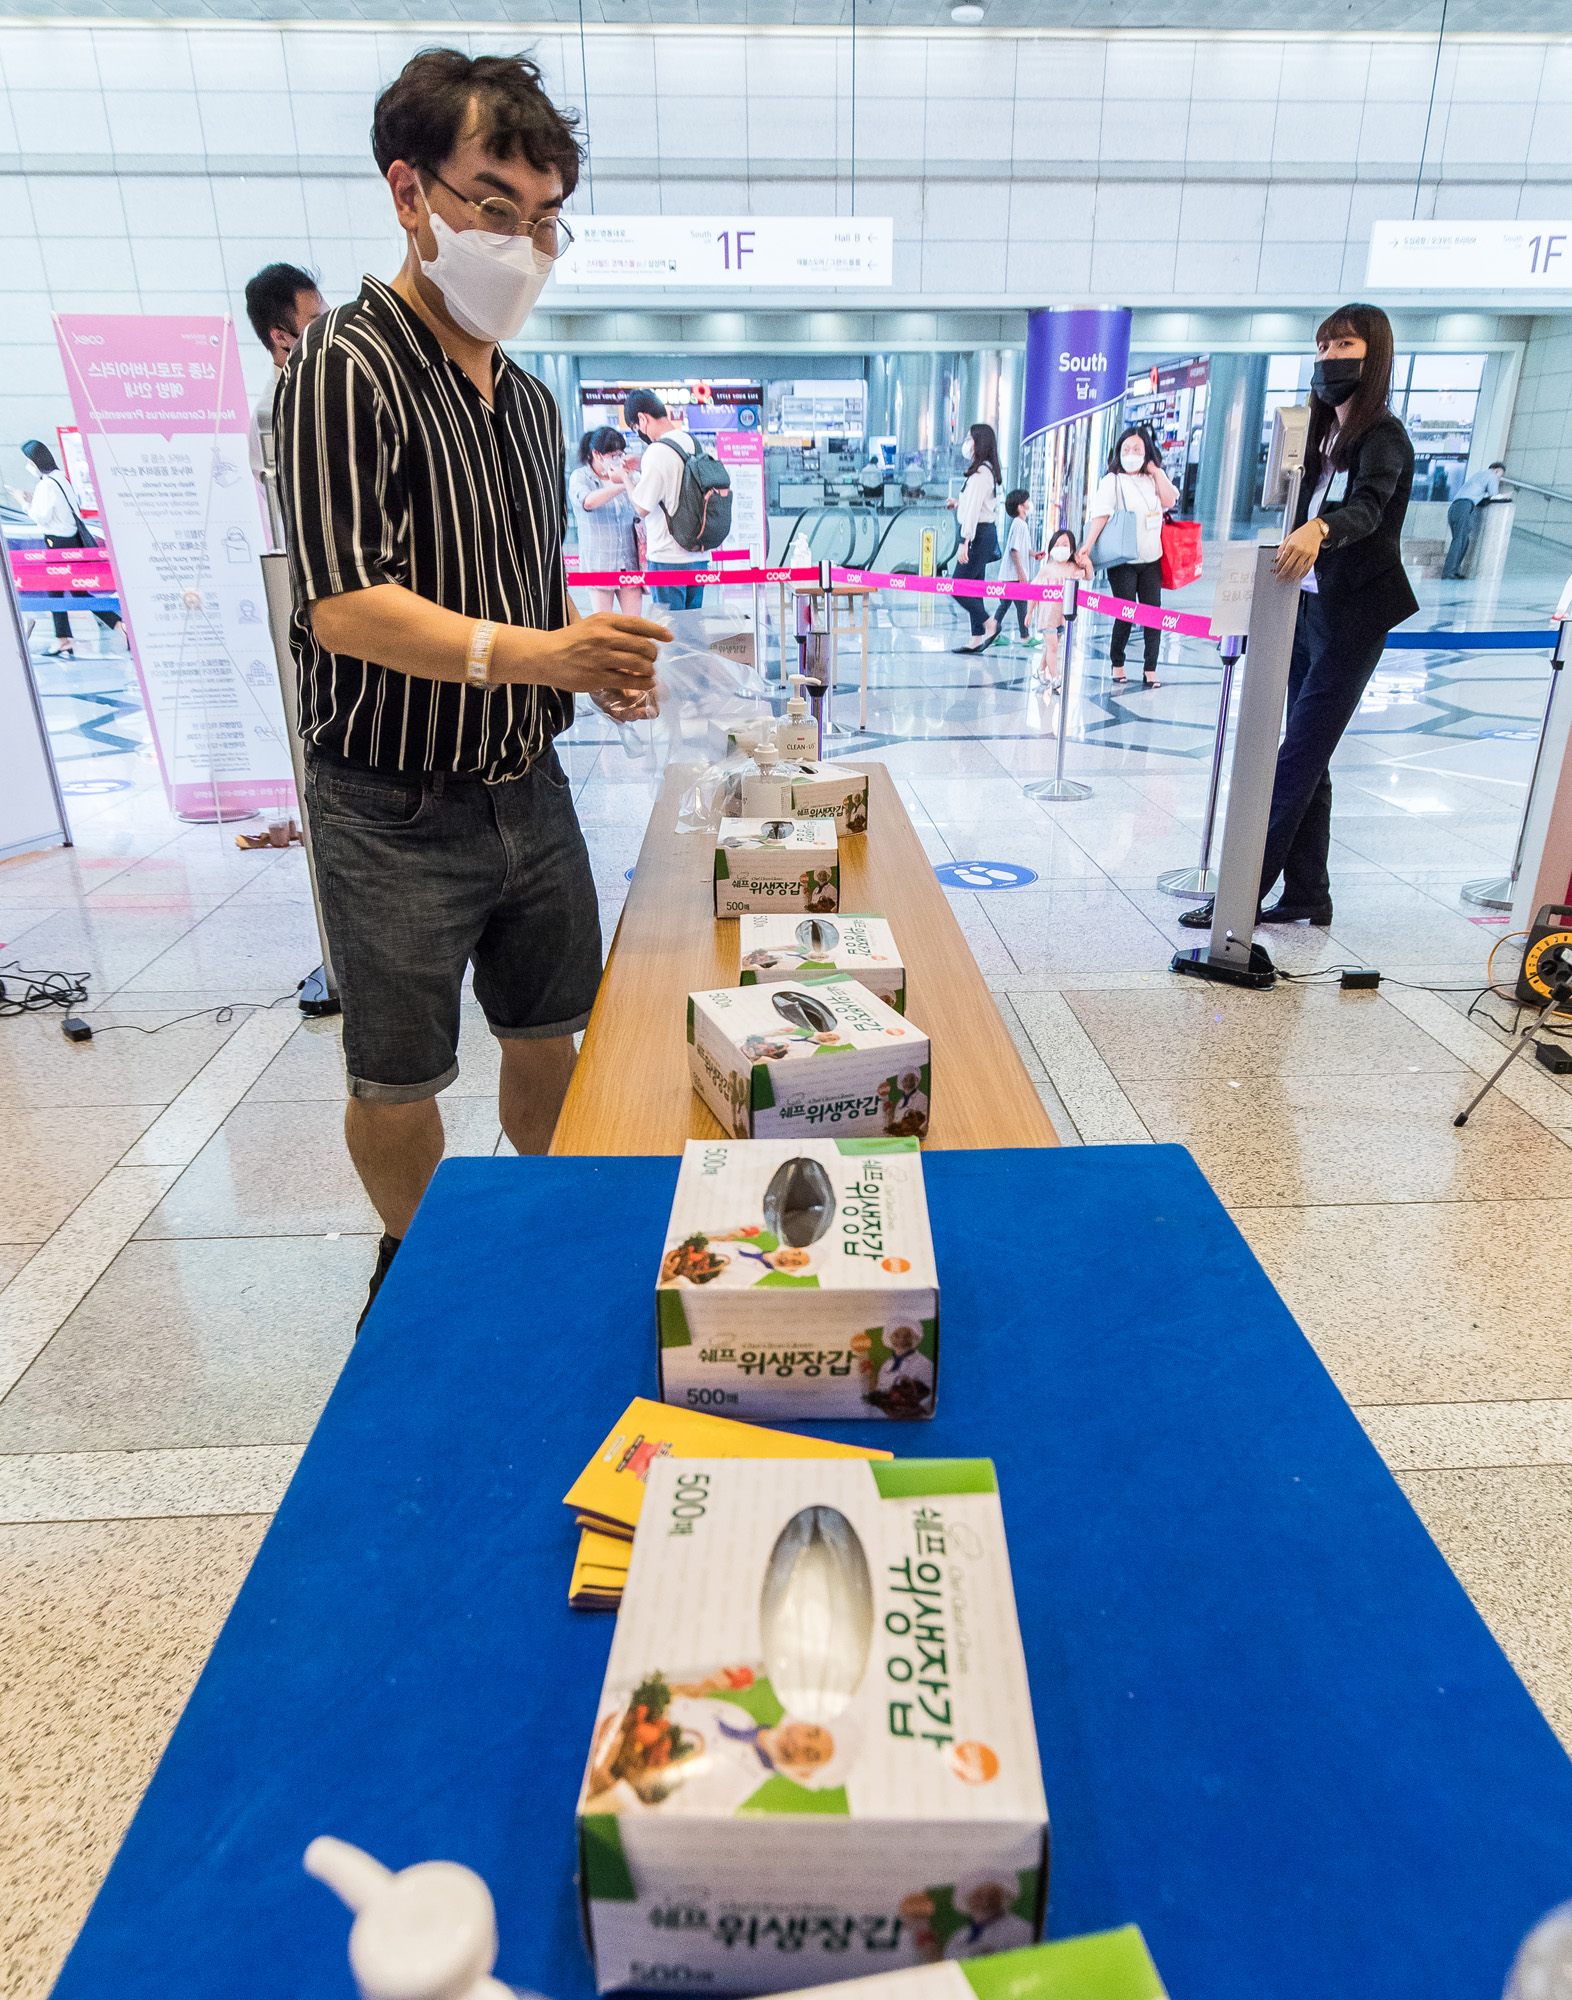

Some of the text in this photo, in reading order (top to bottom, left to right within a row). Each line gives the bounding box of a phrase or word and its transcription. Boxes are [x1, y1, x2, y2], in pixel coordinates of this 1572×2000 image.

[834, 232, 851, 242] Hall
[717, 231, 756, 270] 1F
[1528, 235, 1567, 273] 1F
[1058, 352, 1107, 372] South
[24, 550, 47, 560] coex
[61, 549, 83, 560] coex
[98, 550, 109, 558] co
[46, 564, 72, 576] coex
[695, 571, 721, 583] coex
[766, 568, 792, 581] coex
[71, 575, 100, 588] coex
[619, 572, 646, 584] coex
[846, 572, 862, 584] coex
[889, 576, 906, 589] coex
[936, 580, 955, 593] coex
[986, 582, 1006, 597] coex
[1042, 584, 1064, 600] coex
[1087, 594, 1101, 610] coex
[1121, 604, 1137, 619] coex
[1161, 614, 1180, 629] coex
[796, 805, 846, 818] 쉐프 위생장갑
[732, 879, 801, 896] 쉐프 위생장갑
[726, 901, 750, 911] 500매
[826, 996, 885, 1032] 위생장갑
[779, 1095, 882, 1124] 쉐프 위생장갑
[701, 1148, 728, 1176] 500매
[842, 1159, 885, 1261] 쉐프 위생장갑
[697, 1348, 856, 1378] 쉐프 위생장갑
[686, 1388, 739, 1405] 500매
[667, 1473, 711, 1536] 500매
[885, 1506, 954, 1752] 쉐프 위생장갑
[650, 1905, 901, 1951] 쉐프 위생장갑
